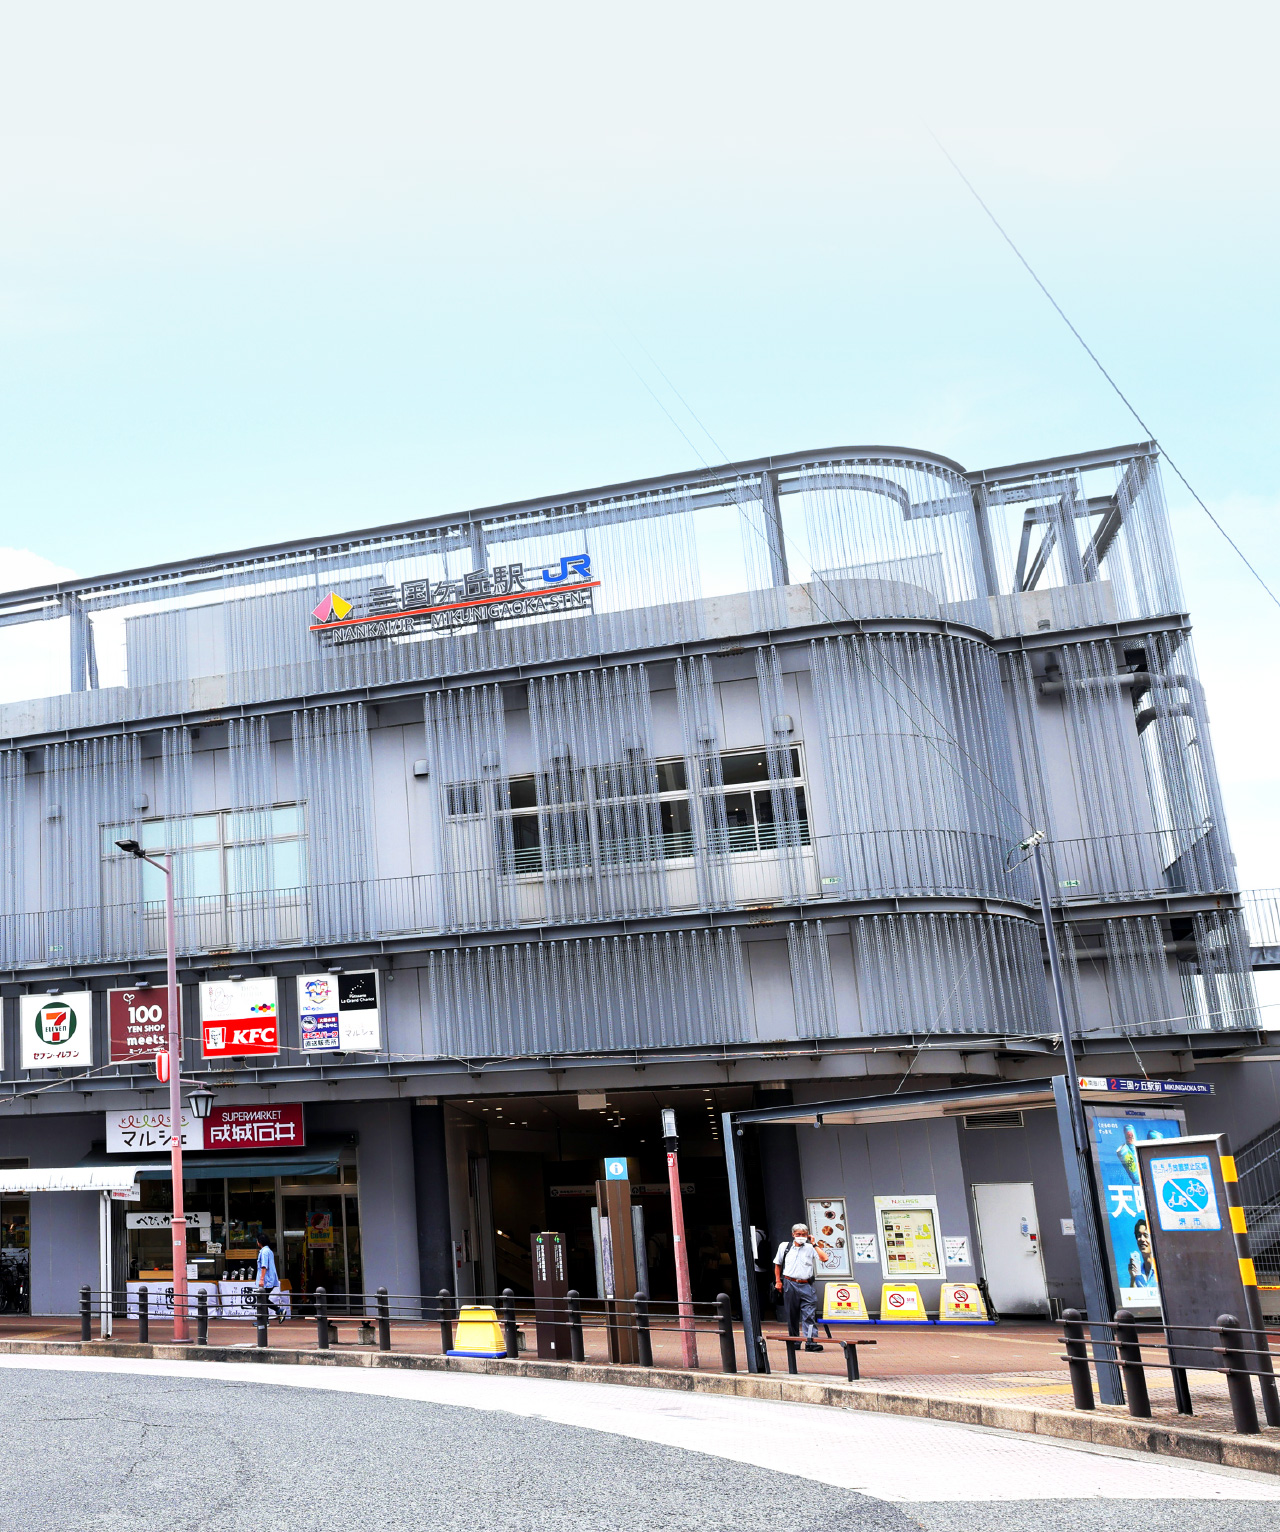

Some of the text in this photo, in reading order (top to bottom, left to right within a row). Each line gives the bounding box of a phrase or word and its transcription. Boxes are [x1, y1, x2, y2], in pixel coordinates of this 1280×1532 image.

[542, 553, 591, 583] JR
[332, 590, 587, 643] NANKAI/JR MIKUNIGAOKA STN.
[128, 1004, 163, 1024] 100
[127, 1024, 166, 1033] YEN SHOP
[231, 1027, 275, 1045] KFC
[1110, 1078, 1117, 1090] 2
[1119, 1080, 1162, 1092] 三国ヶ丘駅前
[1164, 1083, 1198, 1092] MIKUNIGAOKA
[221, 1110, 282, 1122] SUPERMARKET
[210, 1121, 296, 1144] 成城石井
